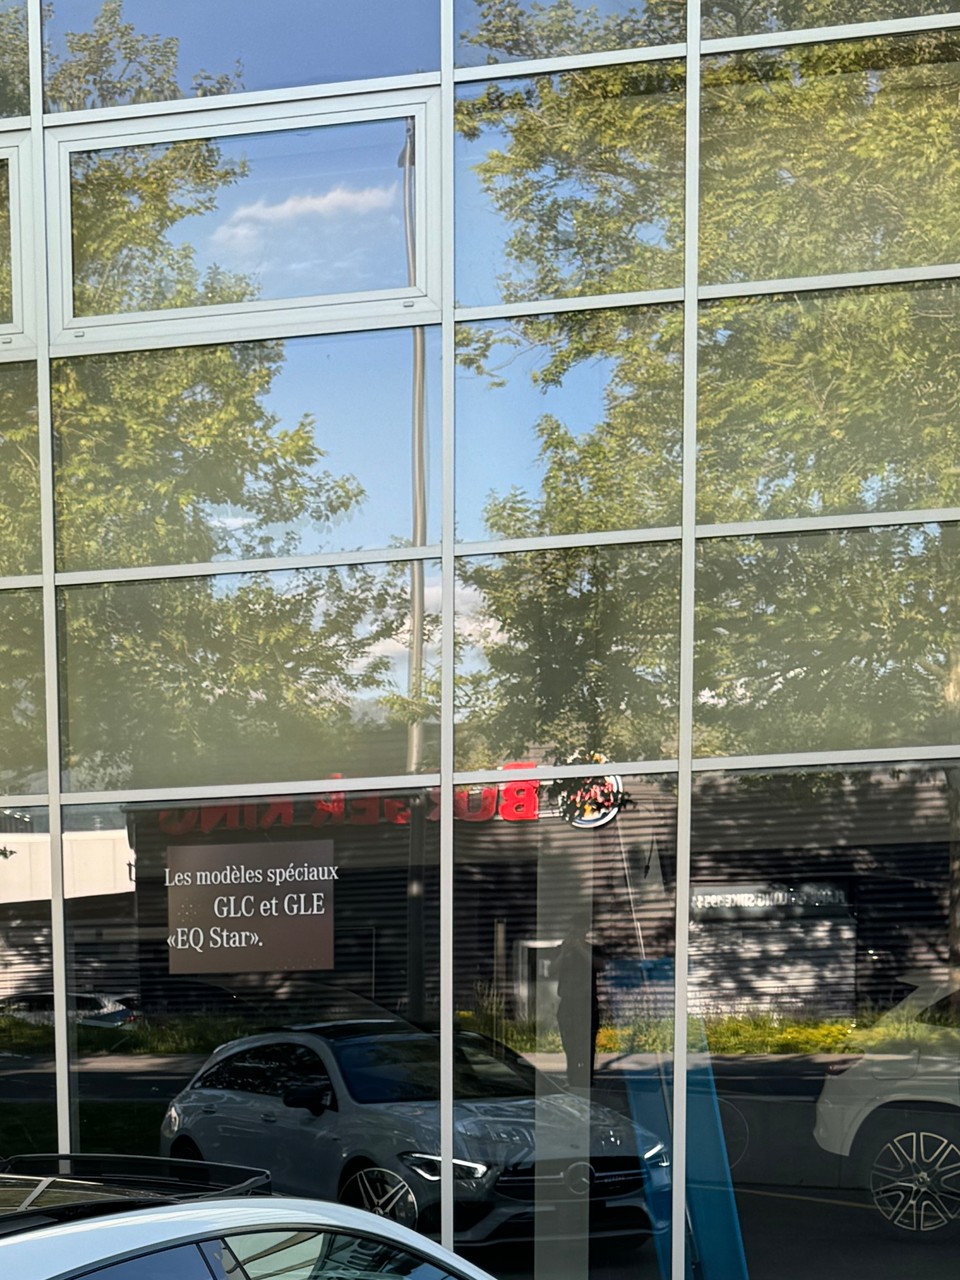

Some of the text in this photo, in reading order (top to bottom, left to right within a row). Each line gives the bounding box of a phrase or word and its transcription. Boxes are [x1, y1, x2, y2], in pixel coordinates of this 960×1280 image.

[164, 862, 339, 887] Les modèles spéciaux
[213, 892, 325, 918] GLC et GLE
[166, 926, 264, 953] «EQ Star».
